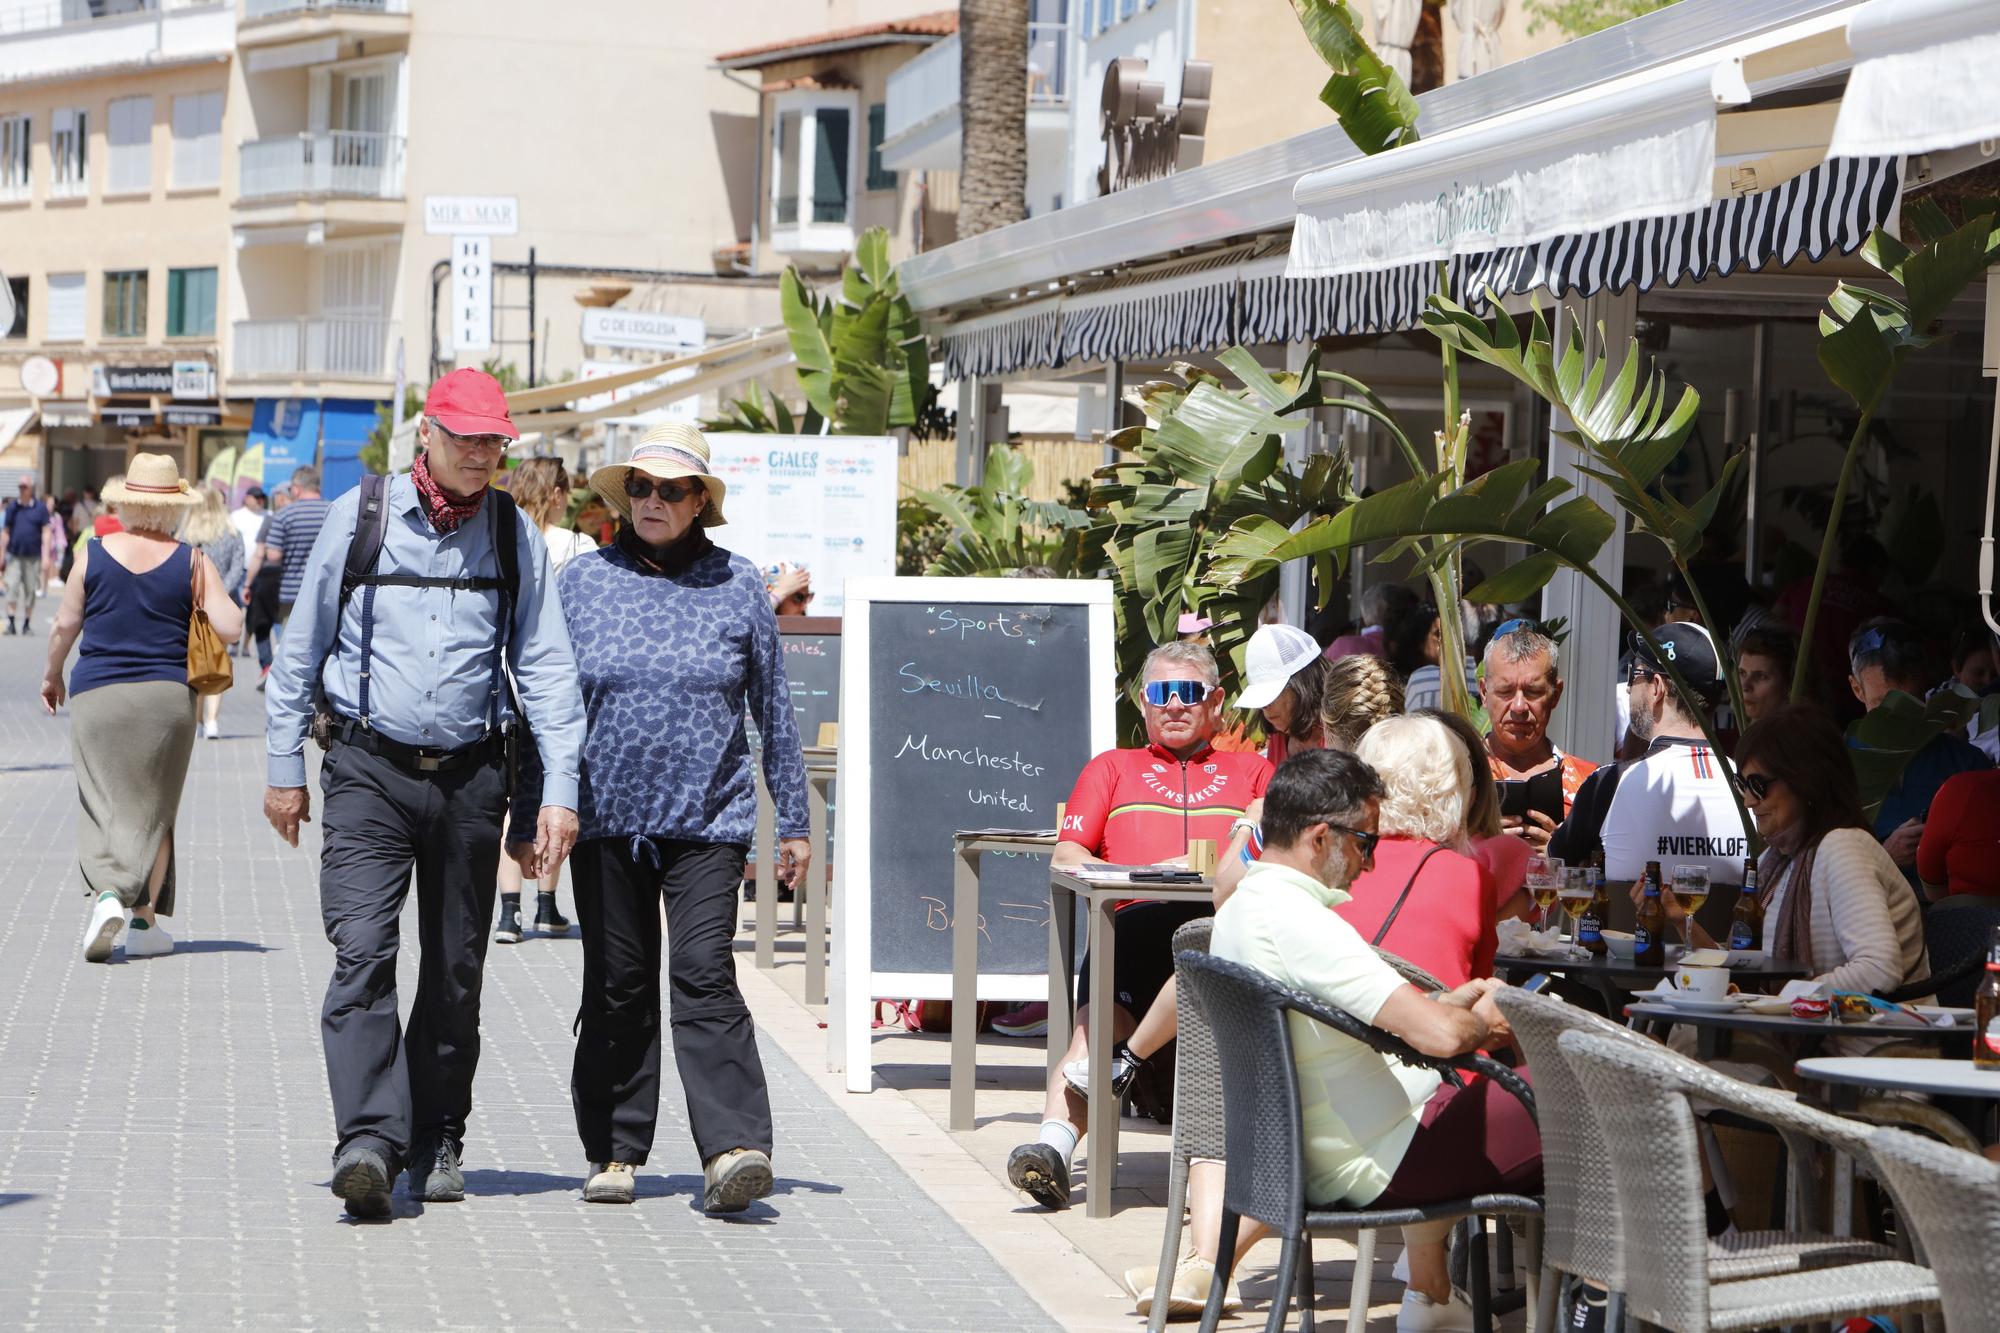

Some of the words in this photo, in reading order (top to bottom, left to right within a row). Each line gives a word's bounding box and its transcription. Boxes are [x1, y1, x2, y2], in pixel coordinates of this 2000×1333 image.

[430, 204, 512, 220] MIRAMAR
[463, 242, 480, 342] HOTEL
[938, 609, 1024, 641] Sports
[899, 662, 1007, 702] Sevilla
[894, 734, 1045, 777] Manchester
